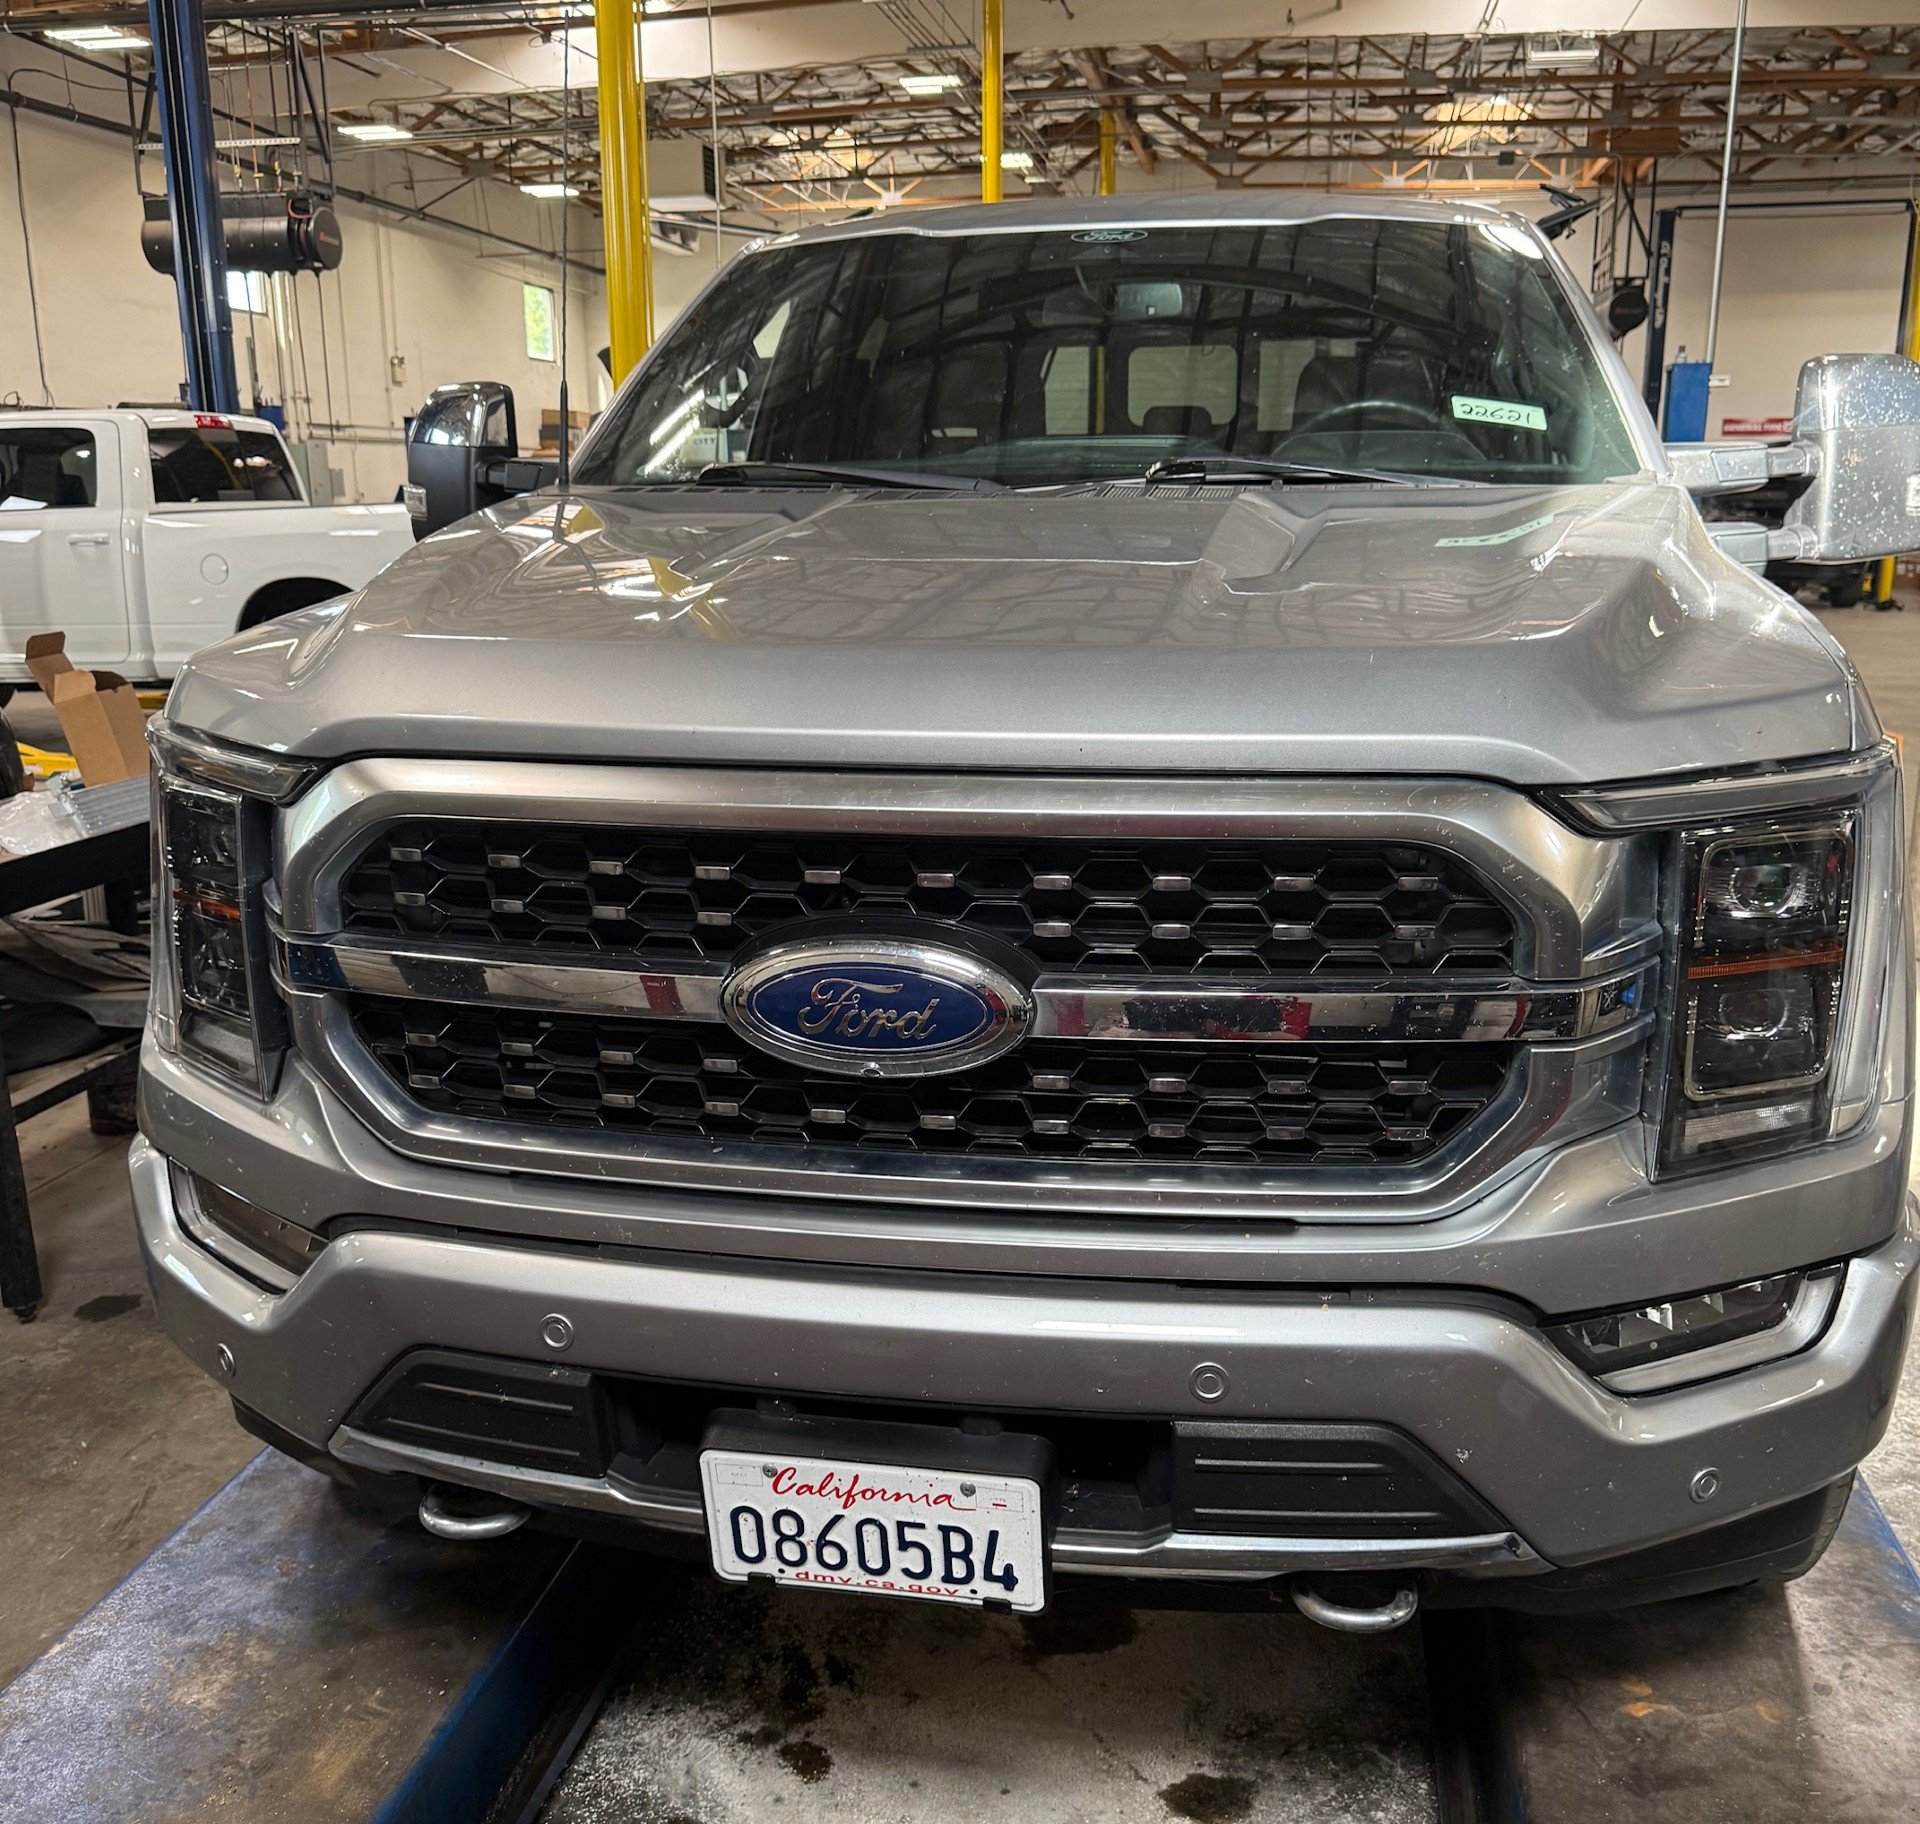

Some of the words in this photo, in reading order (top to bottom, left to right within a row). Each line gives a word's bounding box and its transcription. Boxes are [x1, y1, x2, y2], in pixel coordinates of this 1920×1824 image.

[1083, 229, 1135, 241] Ford
[1460, 403, 1530, 425] 22621
[798, 977, 940, 1041] Ford
[771, 1466, 977, 1512] California
[730, 1505, 1019, 1592] 08605B4
[795, 1569, 960, 1597] dmv.ca.gov
